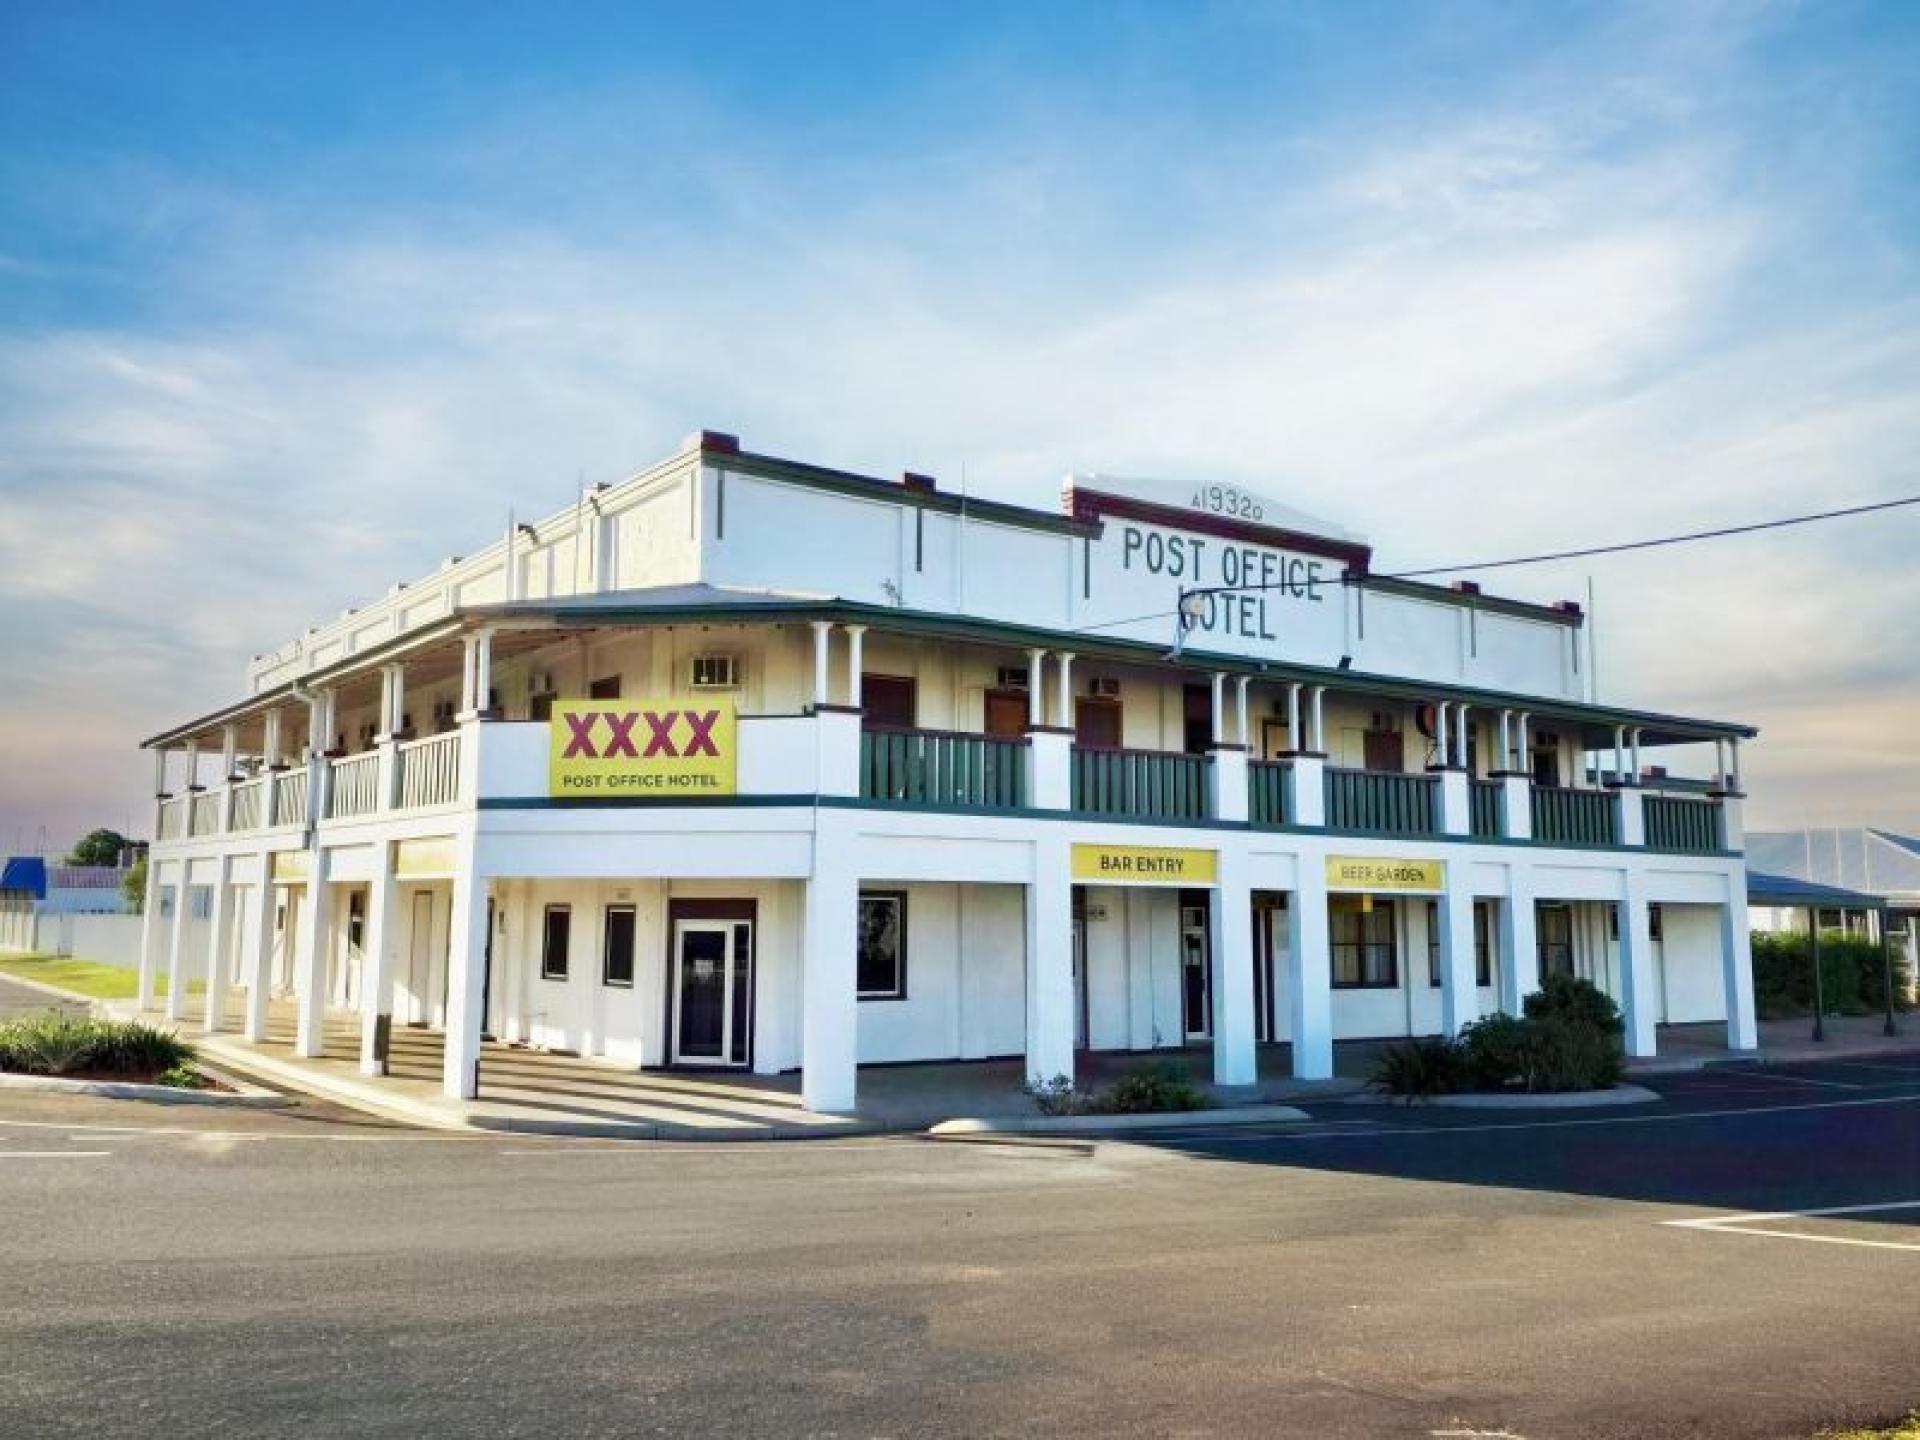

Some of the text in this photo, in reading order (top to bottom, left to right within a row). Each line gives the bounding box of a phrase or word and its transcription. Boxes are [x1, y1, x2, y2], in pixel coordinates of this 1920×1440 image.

[1123, 527, 1323, 601] POST OFFICE
[562, 710, 721, 759] XXXX
[563, 774, 718, 788] POST OFFICE HOTEL
[1100, 855, 1185, 874] BAR ENTRY
